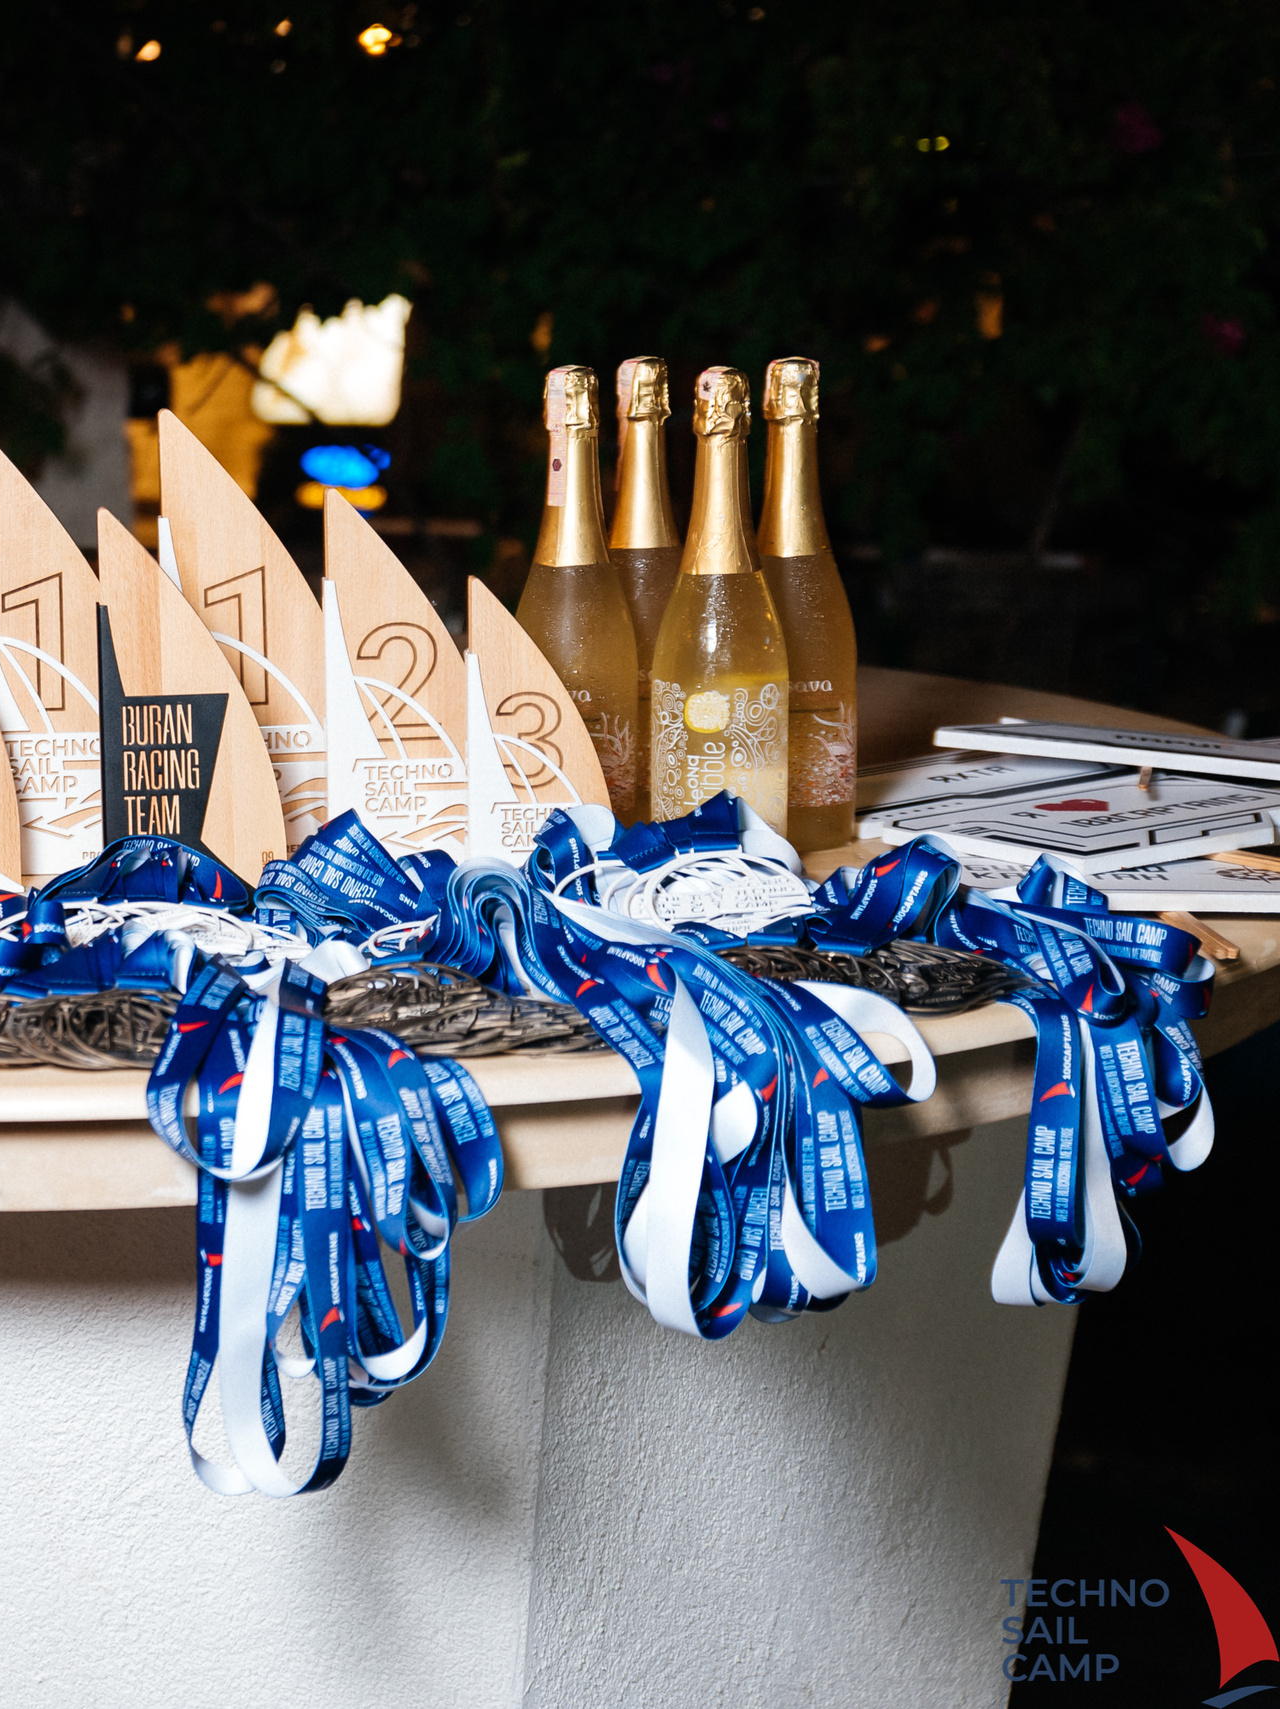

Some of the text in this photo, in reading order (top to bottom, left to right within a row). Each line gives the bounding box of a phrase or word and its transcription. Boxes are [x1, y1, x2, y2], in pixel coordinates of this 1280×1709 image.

[1, 571, 66, 711] 1
[204, 566, 269, 706] 1
[357, 622, 441, 742] 2
[122, 703, 193, 746] BURAN
[495, 691, 564, 789] 3
[123, 748, 200, 791] RACING
[364, 763, 455, 782] TECHNO
[365, 781, 412, 798] SAIL
[698, 741, 726, 800] ubble
[123, 795, 181, 836] TEAM
[365, 797, 428, 813] CAMP
[1010, 810, 1048, 820] Я
[274, 872, 326, 905] TECHNO SAIL
[298, 853, 344, 889] SAIL CAMP
[362, 868, 385, 888] WEB 3.0
[850, 879, 878, 920] 100CAPTAINS
[892, 870, 929, 924] 100CAPTAINS
[1083, 917, 1168, 947] TECHNO SAIL CAMP
[1070, 954, 1094, 978] CAMP
[1153, 972, 1181, 995] CAMP
[589, 1005, 656, 1070] TECHNO SAIL CAMP
[700, 989, 731, 1023] TECHNO
[720, 1010, 746, 1037] SAIL
[734, 1027, 767, 1056] CAMP
[804, 1023, 821, 1041] WEB
[1165, 1026, 1190, 1051] CAMP
[280, 1035, 305, 1055] SAIL
[820, 1018, 891, 1096] TECHNO SAIL CAMP
[1061, 1014, 1073, 1080] 100CAPTAINS
[278, 1055, 303, 1092] TECHNO
[1099, 1045, 1124, 1106] WEB 3.0 BLOCKCHAIN
[1115, 1039, 1157, 1134] TECHNO SAIL CAMP
[422, 1062, 478, 1146] TECHNO SAIL CAMP
[359, 1121, 374, 1138] WEB
[398, 1087, 445, 1184] TECHNO SAIL CAMP
[302, 1105, 328, 1212] TECHNO SAIL CAMP
[376, 1113, 407, 1216] TECHNO SAIL CAMP
[817, 1110, 847, 1212] TECHNO SAIL CAMP
[1030, 1125, 1056, 1220] TECHNO SAIL CAMP
[1056, 1160, 1071, 1197] BLOCKCHAIN
[330, 1195, 342, 1210] WEB
[770, 1150, 784, 1252] TECHNO SAIL CAMP
[852, 1193, 865, 1210] WEB
[1056, 1197, 1069, 1208] 3.0
[1056, 1208, 1069, 1222] WEB
[739, 1187, 768, 1281] TECHNO SAIL CAMP
[274, 1260, 306, 1317] SAIL CAMP
[329, 1231, 341, 1305] 100CAPTAINS
[322, 1357, 339, 1461] TECHNO SAIL CAMP
